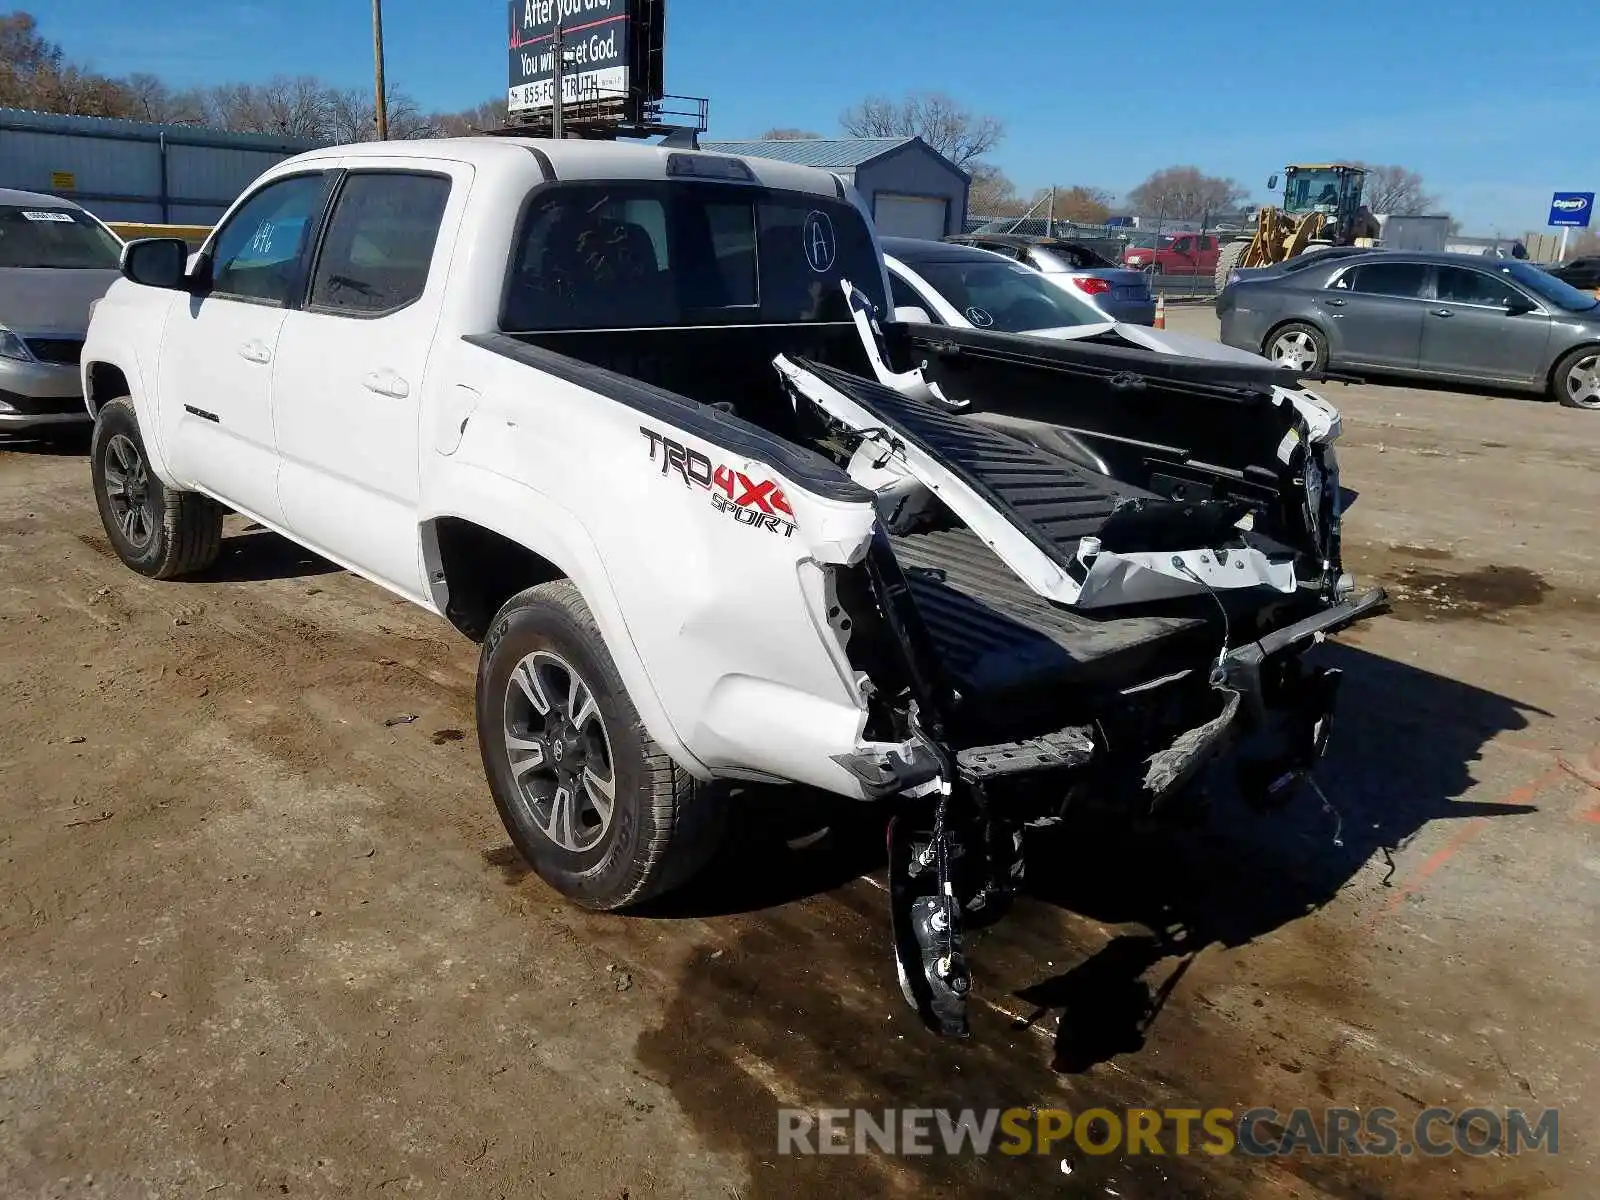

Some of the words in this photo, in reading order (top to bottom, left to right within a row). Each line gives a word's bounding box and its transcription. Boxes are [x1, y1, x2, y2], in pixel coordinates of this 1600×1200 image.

[524, 0, 553, 29] After
[556, 0, 581, 25] you
[521, 53, 537, 76] You
[541, 44, 555, 72] wil
[590, 29, 618, 61] God.
[524, 73, 598, 104] 855-FO-TRUTH
[639, 425, 713, 490] TRD
[711, 492, 798, 538] SPORT
